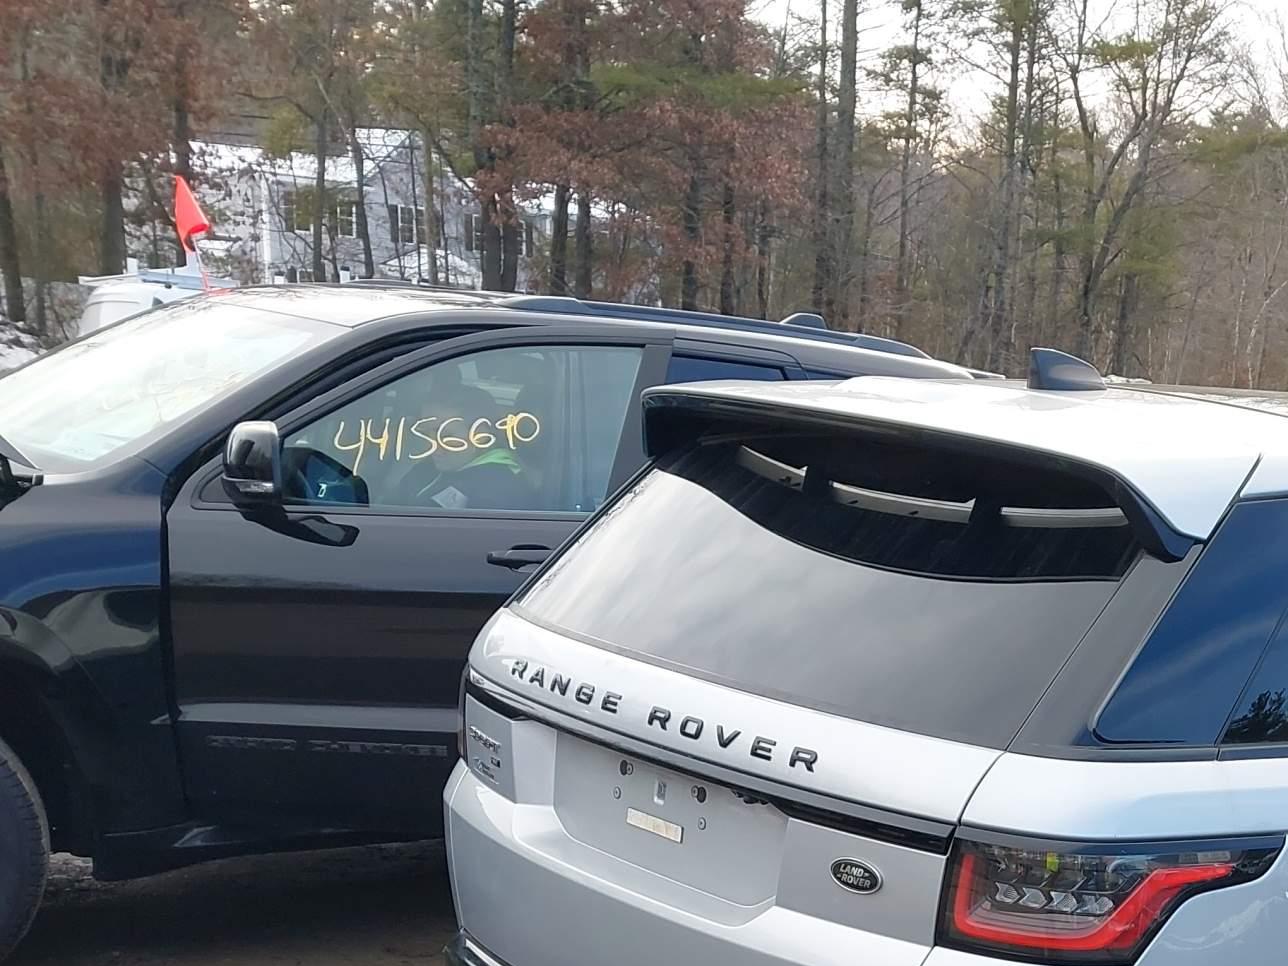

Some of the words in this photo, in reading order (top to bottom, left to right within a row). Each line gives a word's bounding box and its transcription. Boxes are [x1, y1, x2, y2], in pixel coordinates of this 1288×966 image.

[333, 412, 541, 476] 44156690
[511, 659, 623, 714] RANGE
[647, 706, 820, 773] ROVER
[839, 863, 864, 877] LAND
[840, 873, 871, 888] ROVER
